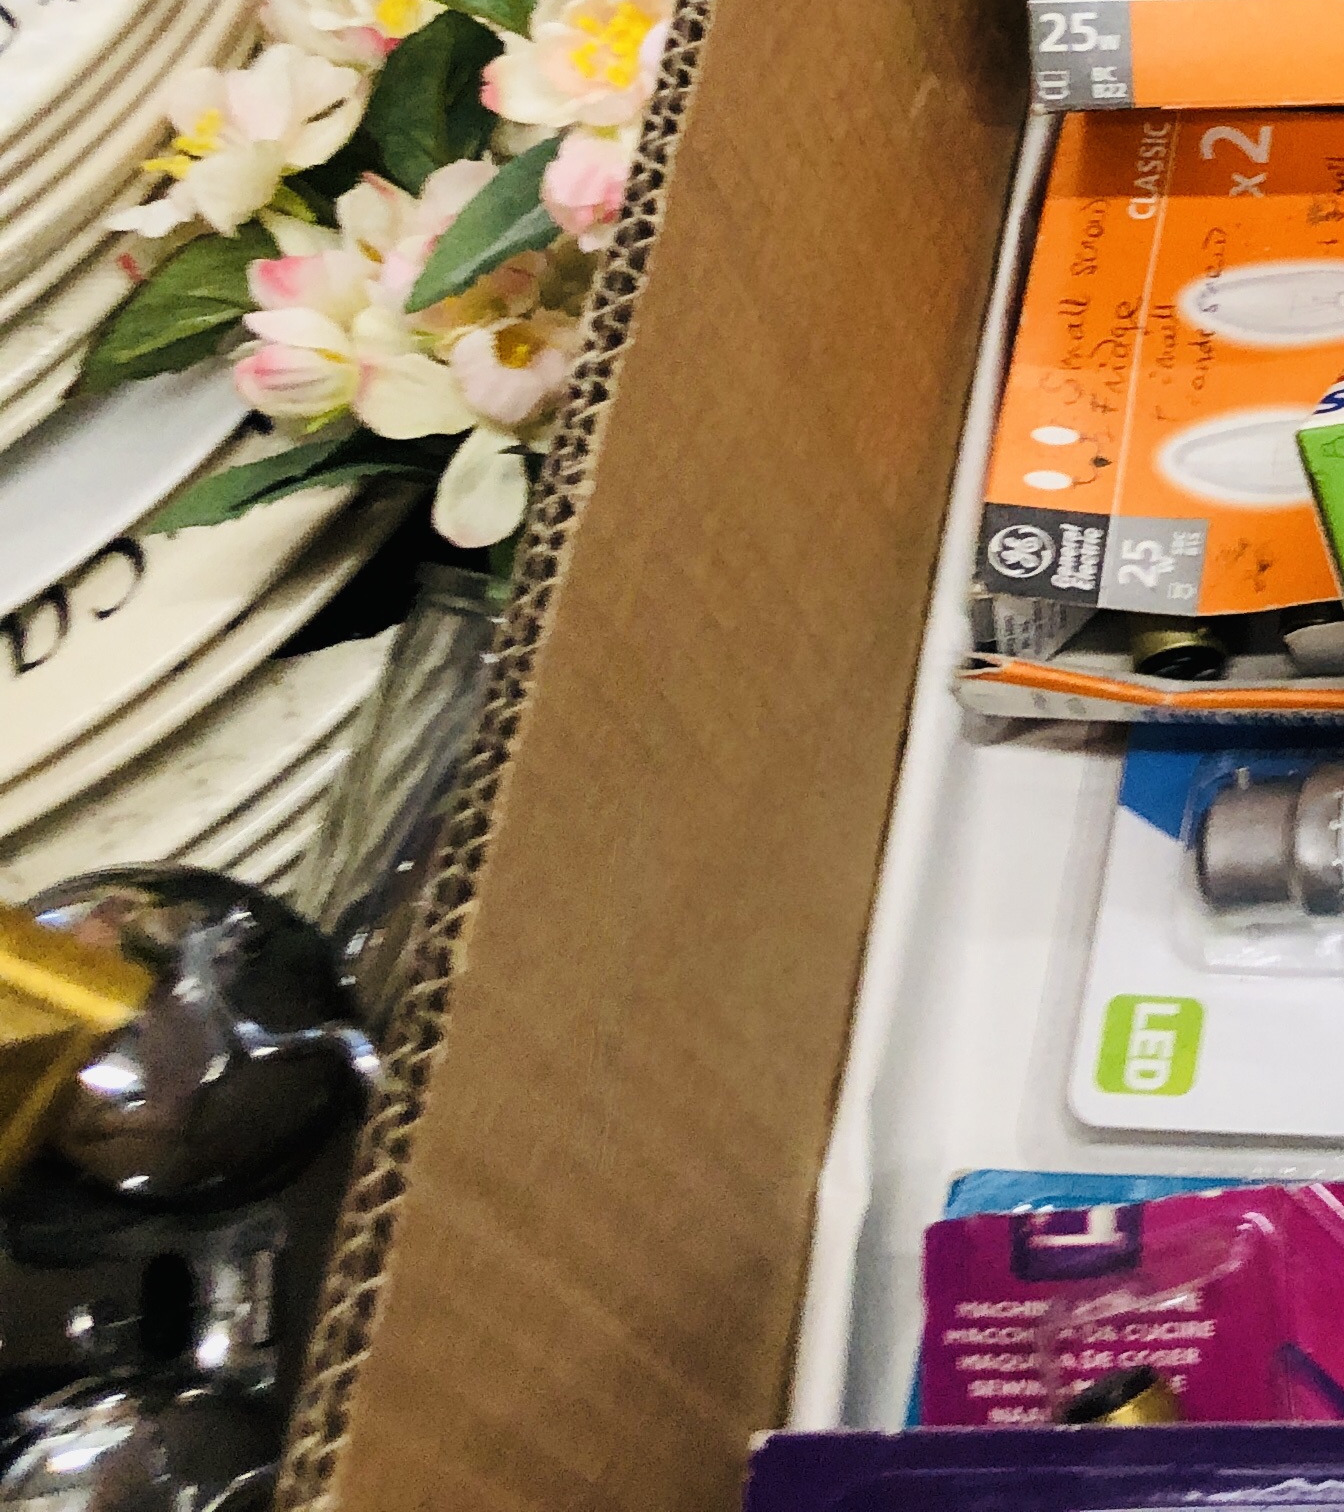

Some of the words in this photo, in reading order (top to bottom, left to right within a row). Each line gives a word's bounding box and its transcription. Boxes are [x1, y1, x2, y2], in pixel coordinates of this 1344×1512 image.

[1128, 122, 1173, 220] CLASSIC
[1199, 125, 1276, 199] x2
[1118, 539, 1160, 588] 25
[1122, 1001, 1182, 1091] LED
